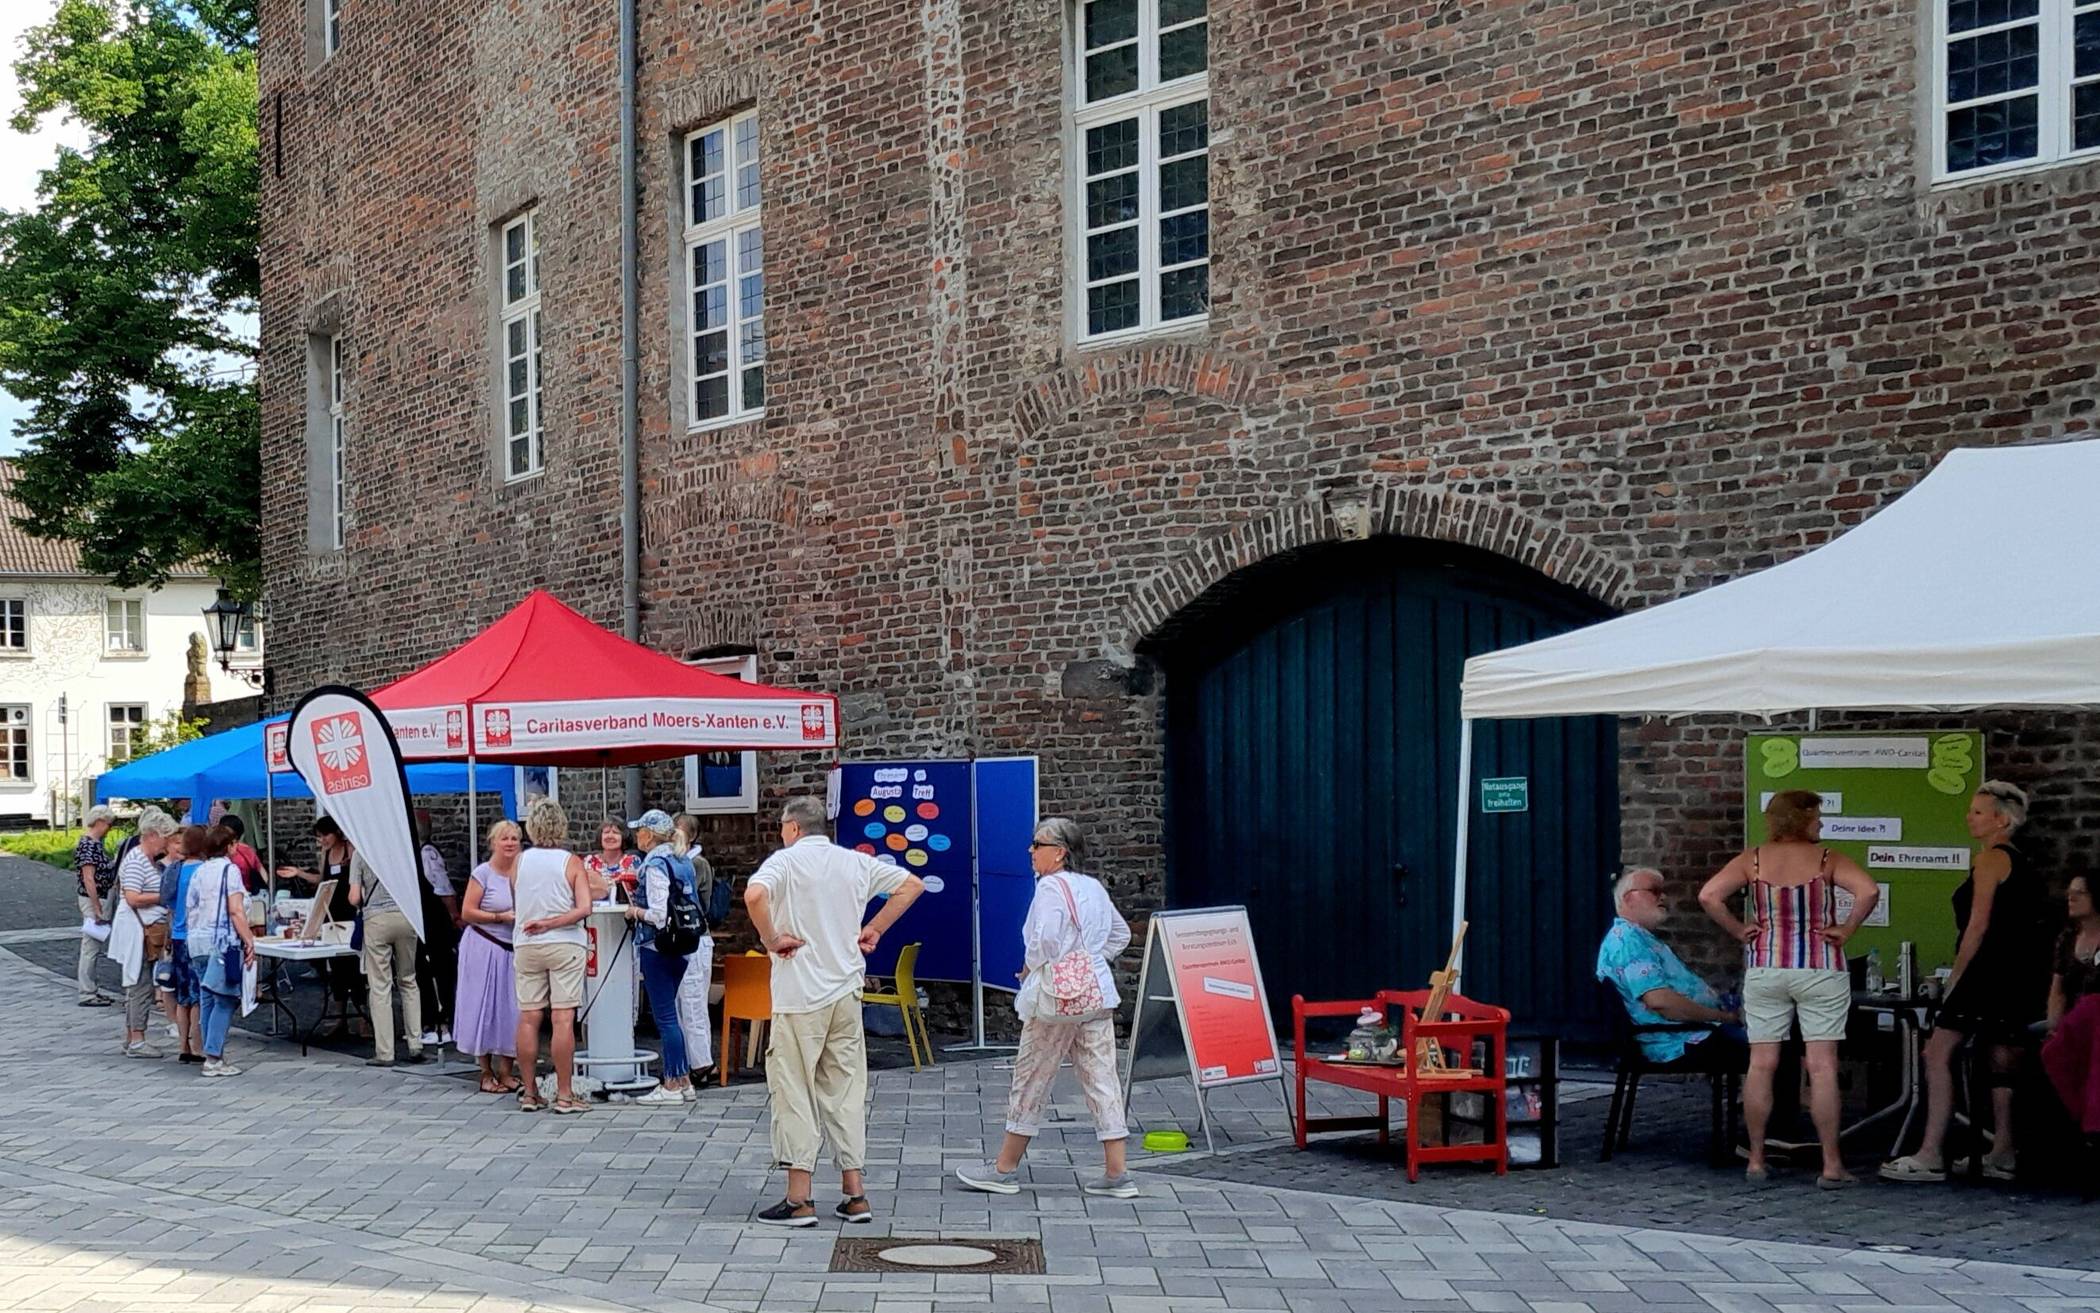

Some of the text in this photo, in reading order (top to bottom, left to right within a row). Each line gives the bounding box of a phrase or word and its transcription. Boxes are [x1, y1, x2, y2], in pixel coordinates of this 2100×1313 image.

[526, 712, 789, 734] Caritasverband Moers-Xanten e.V.
[391, 723, 439, 739] anten e.V.
[1831, 824, 1856, 833] Deine
[1870, 852, 1895, 862] Dein
[1898, 853, 1949, 864] Ehrenamt
